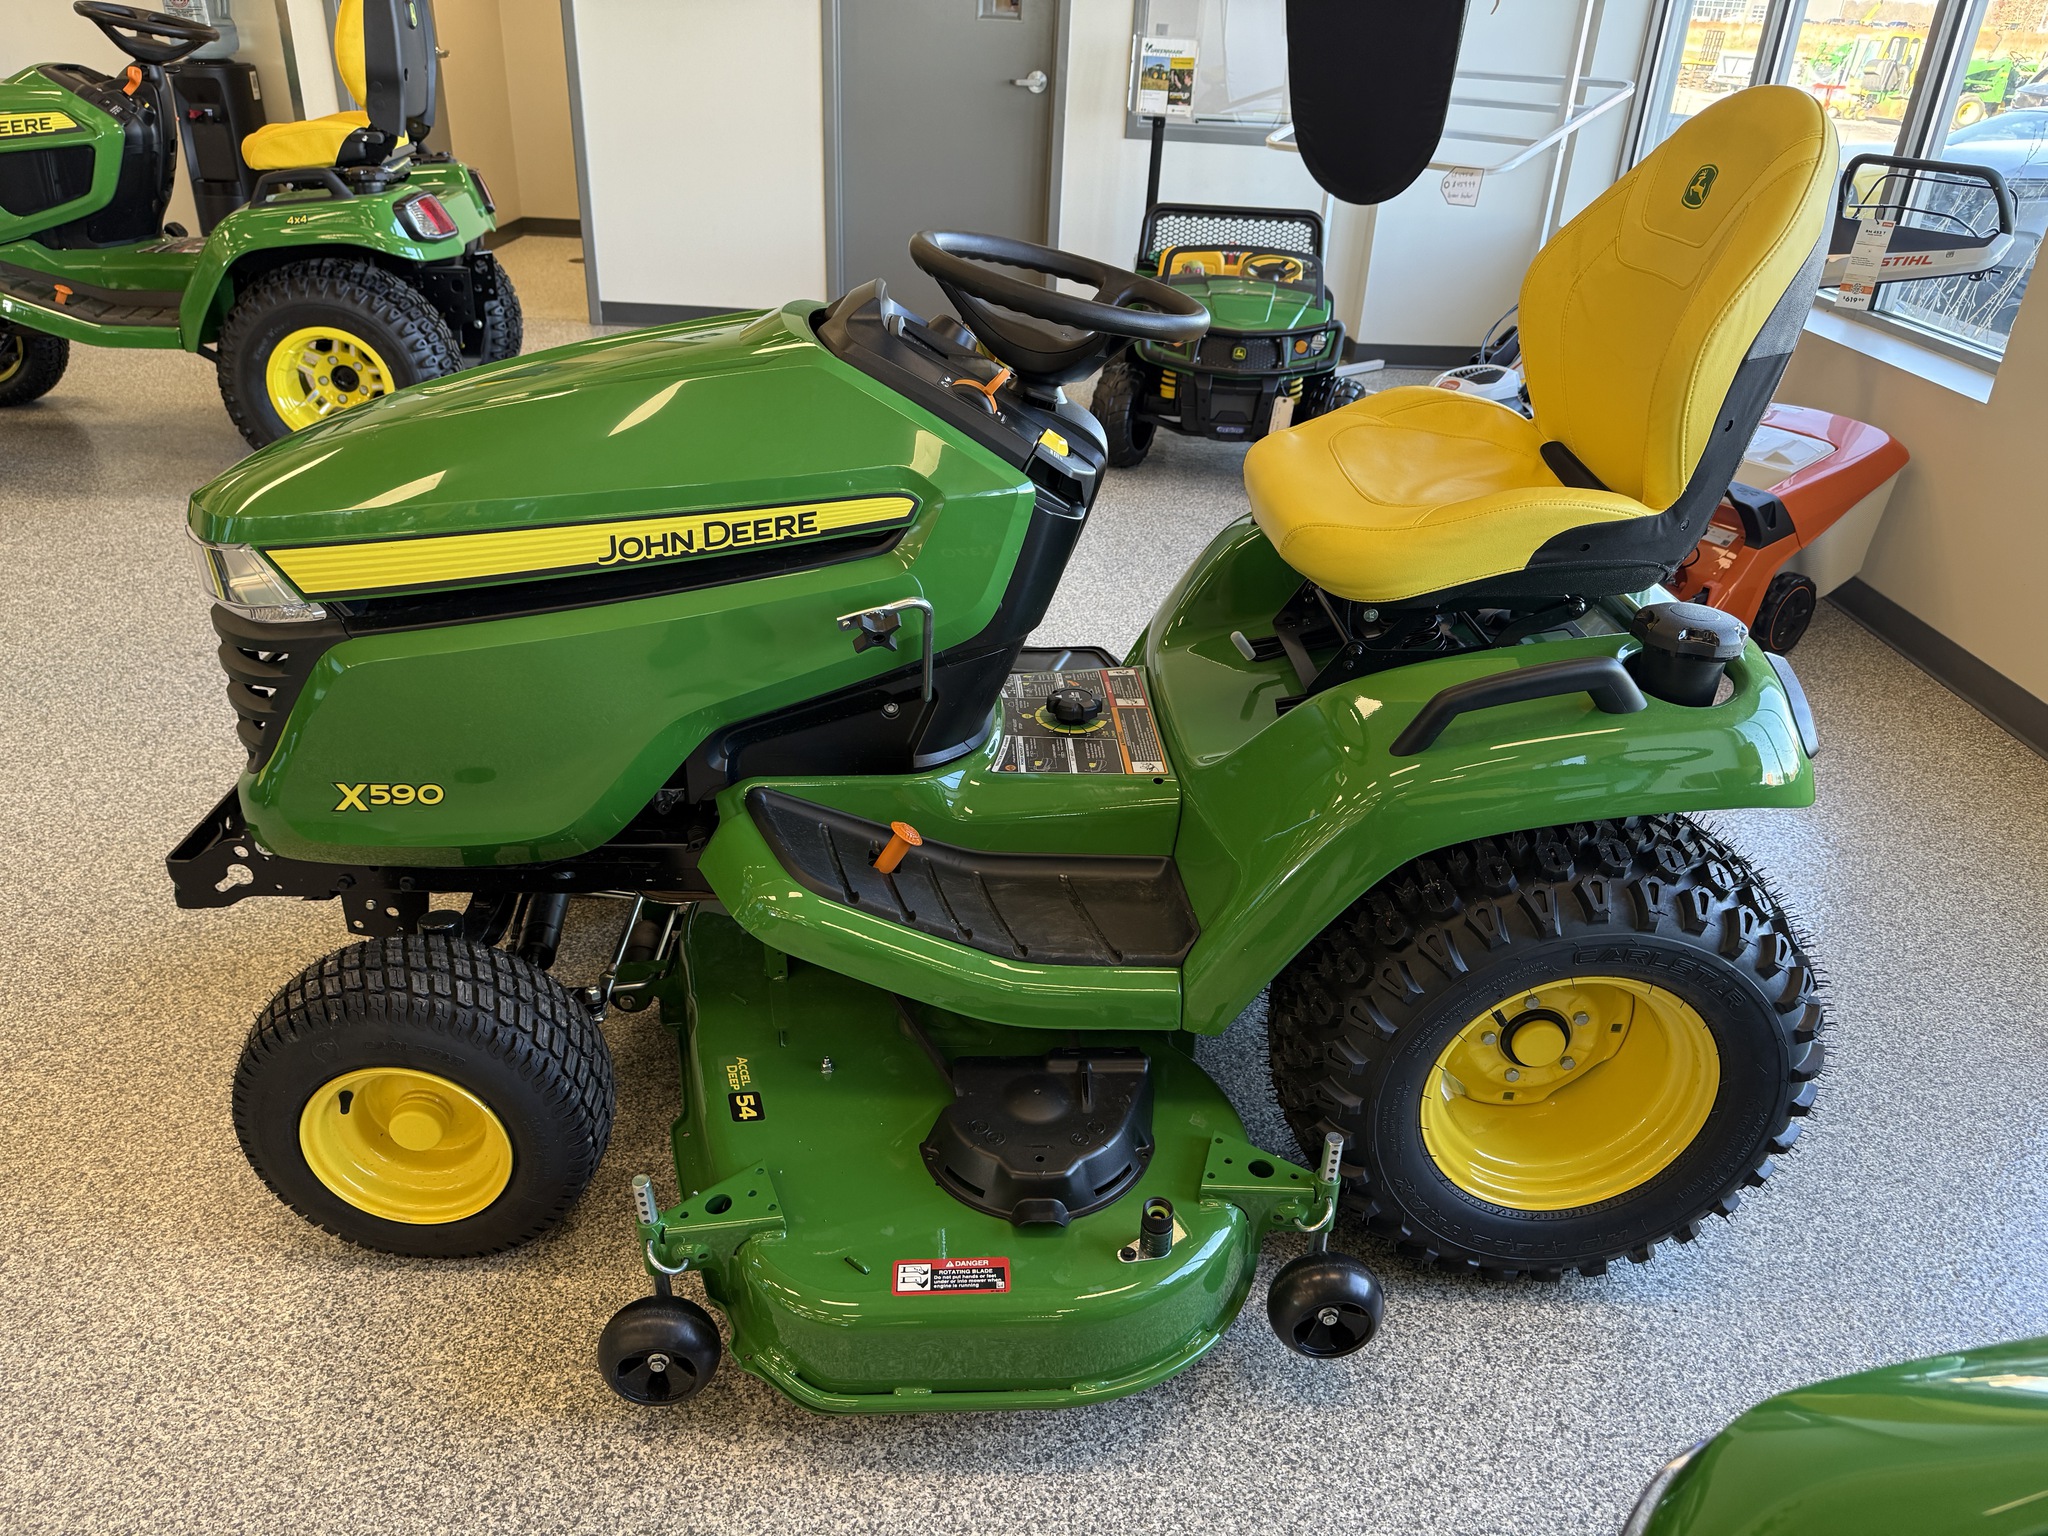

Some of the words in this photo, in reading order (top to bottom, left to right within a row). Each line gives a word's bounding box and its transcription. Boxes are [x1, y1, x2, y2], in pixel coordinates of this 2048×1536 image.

[286, 214, 308, 225] 4x4
[1880, 255, 1933, 267] STIHL
[598, 528, 695, 565] JOHN
[703, 510, 818, 550] DEERE
[331, 781, 446, 813] X590
[1573, 947, 1747, 1010] CARLSTAR
[726, 1065, 740, 1091] DEEP
[736, 1056, 751, 1087] ACCEL
[736, 1094, 758, 1120] 54
